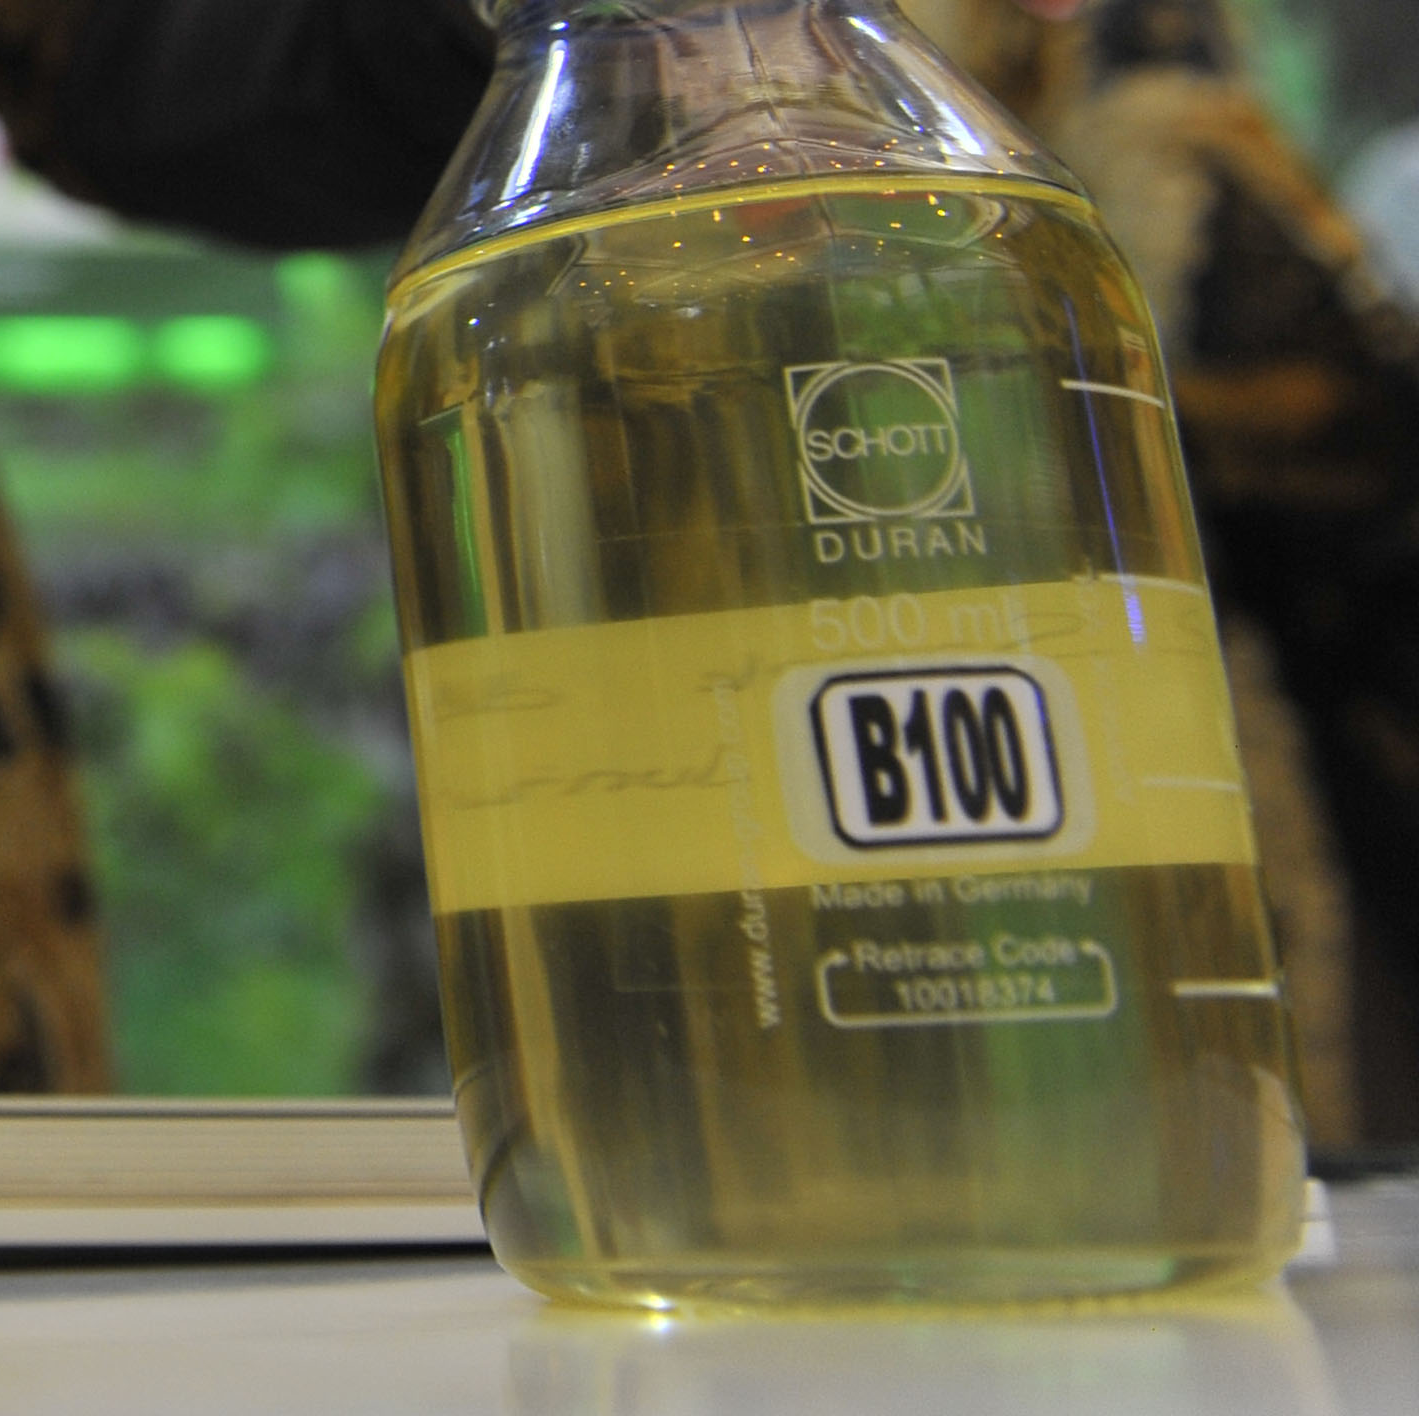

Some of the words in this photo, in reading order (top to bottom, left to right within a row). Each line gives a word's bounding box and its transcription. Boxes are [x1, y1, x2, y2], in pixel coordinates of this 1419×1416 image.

[805, 425, 949, 461] SCHOTT
[813, 521, 987, 563] DURAN
[810, 593, 927, 652] 500
[849, 686, 1031, 827] B100
[812, 882, 904, 911] Made
[953, 874, 1093, 905] Germany
[851, 938, 985, 972] Retrace
[991, 933, 1079, 967] Code
